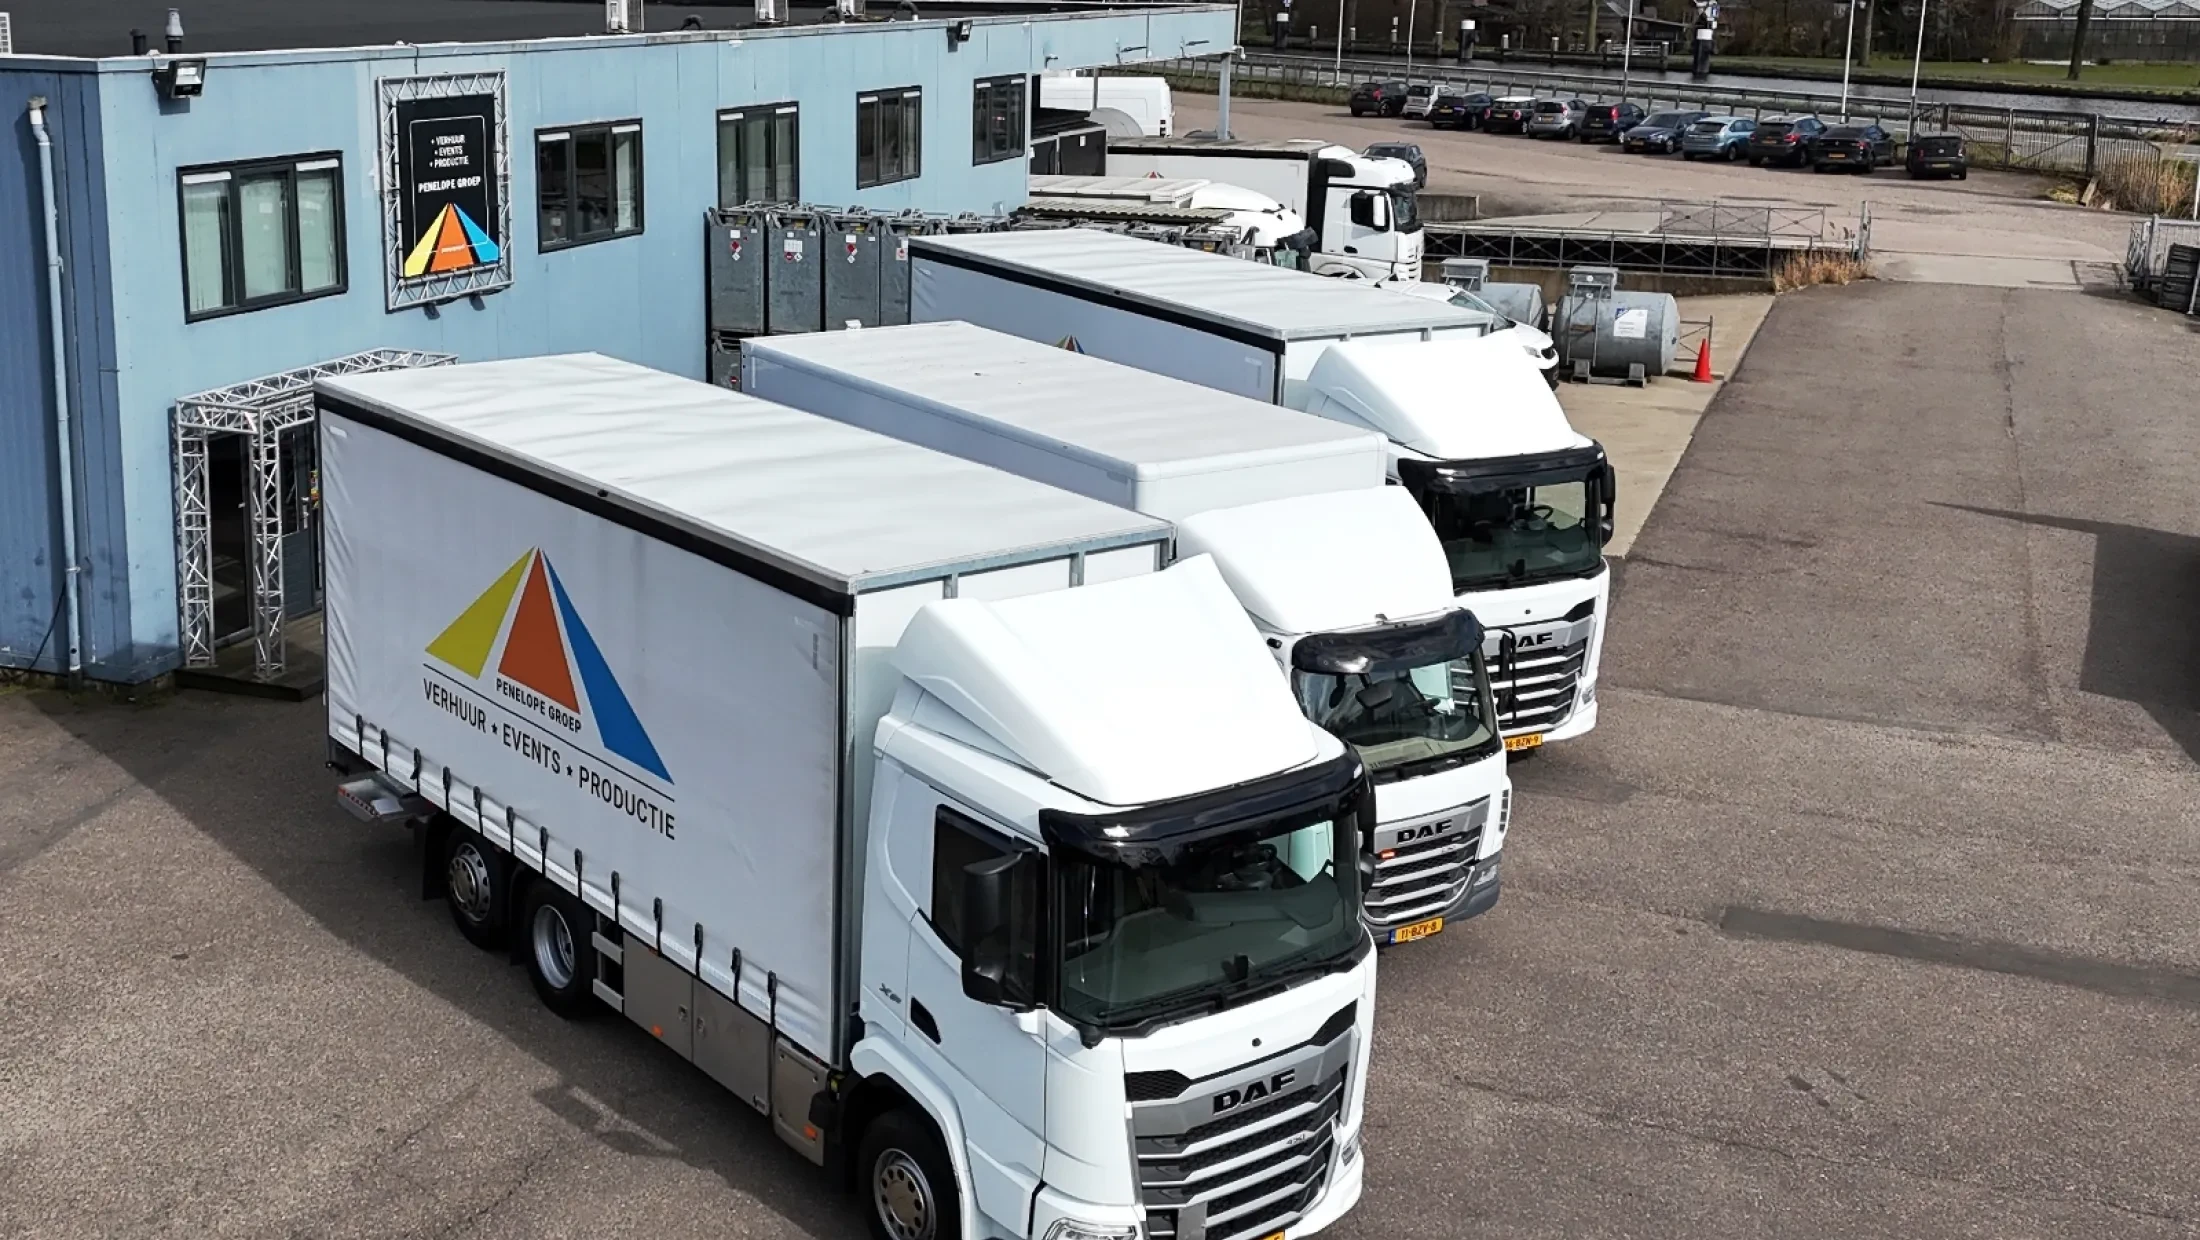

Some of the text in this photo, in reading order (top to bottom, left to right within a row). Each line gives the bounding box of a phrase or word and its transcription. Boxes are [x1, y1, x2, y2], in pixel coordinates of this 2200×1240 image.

[439, 146, 463, 157] EVENTS
[418, 176, 481, 193] PENELOPE GROEP
[1517, 632, 1553, 648] AF
[496, 678, 582, 733] PENELOPE GROEP
[423, 678, 676, 840] VERHUUR EVENTS PRODUCTIE
[1397, 819, 1453, 844] DAF
[1212, 1069, 1296, 1115] DAF
